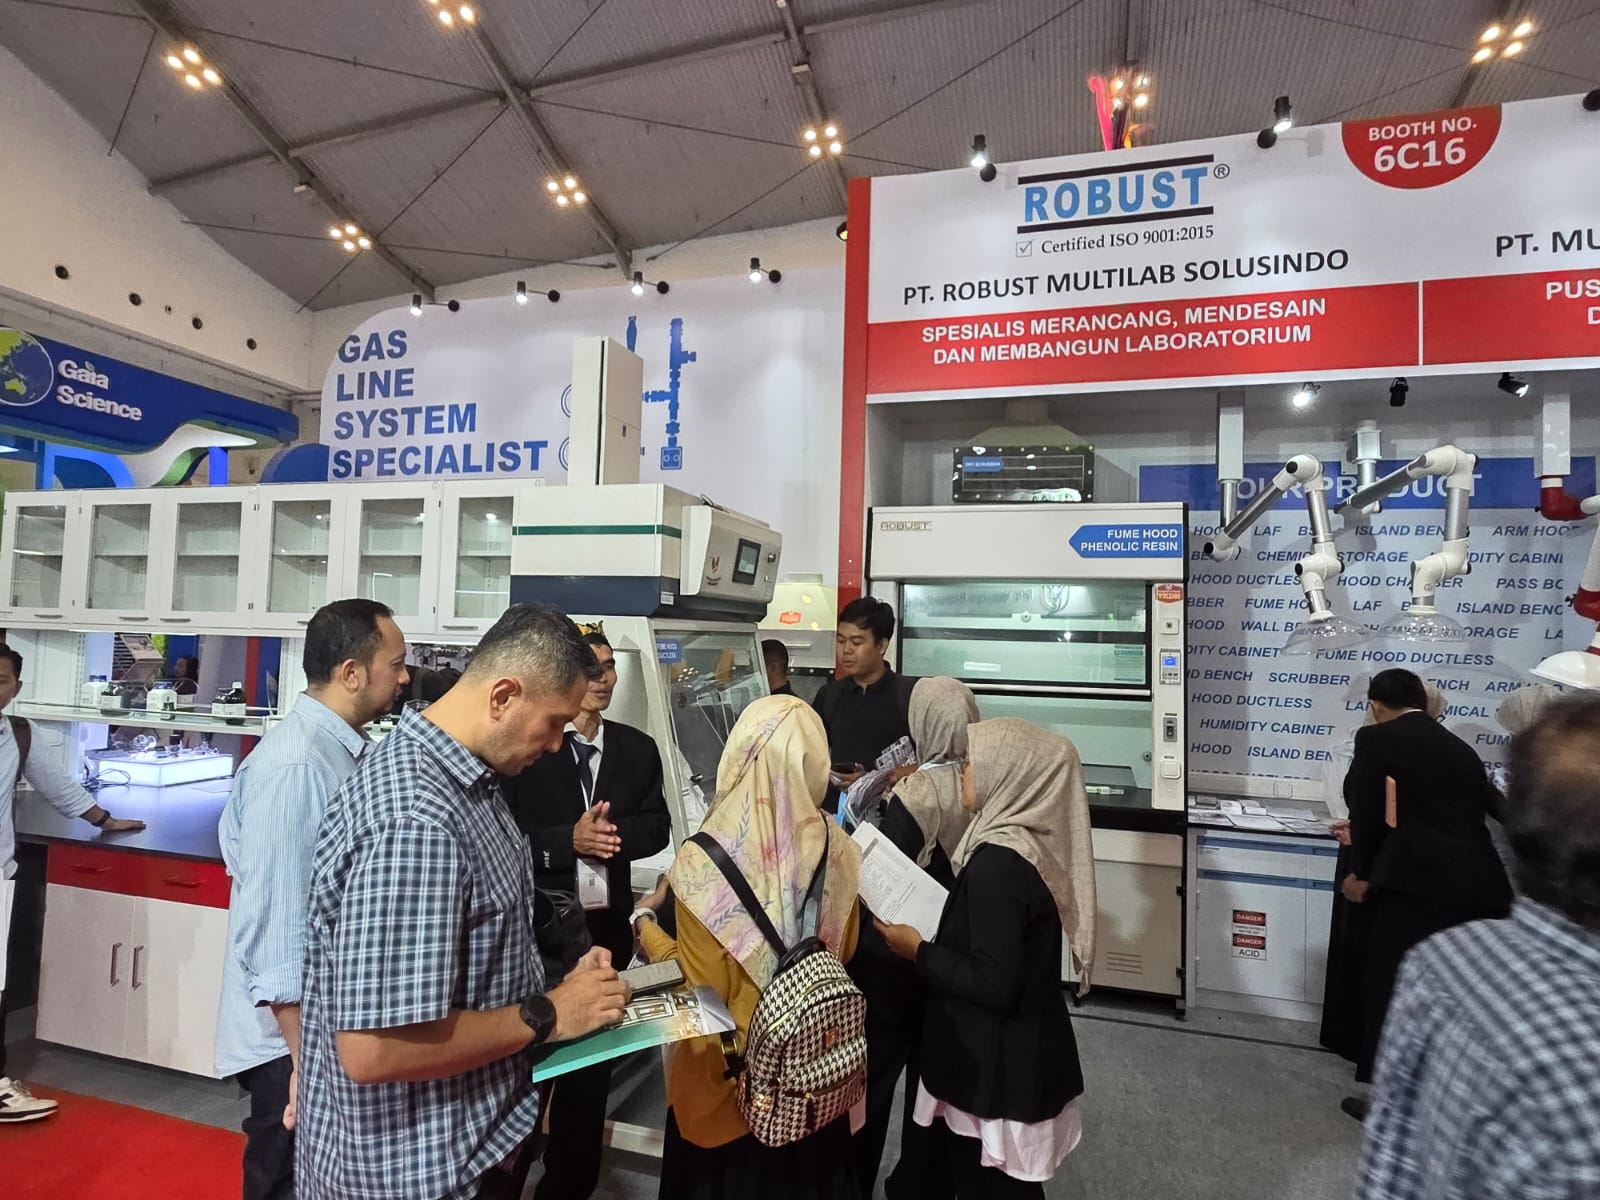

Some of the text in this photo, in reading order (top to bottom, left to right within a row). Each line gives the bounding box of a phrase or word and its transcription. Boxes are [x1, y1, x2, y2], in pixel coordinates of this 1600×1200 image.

[1368, 116, 1478, 142] BOOTH NO.
[1373, 137, 1467, 172] 6C16
[1024, 166, 1208, 223] ROBUST
[1041, 224, 1214, 254] Certified ISO 9001:2015
[1496, 233, 1539, 258] PT.
[903, 248, 1349, 306] PT. ROBUST MULTILAB SOLUSINDO
[921, 297, 1327, 343] SPESIALIS MERANCANG, MENDESAIN
[338, 329, 408, 363] GAS
[932, 324, 1312, 366] DAN MEMBANGUN LABORATORIUM
[58, 360, 109, 389] Gaia
[336, 367, 415, 402] LINE
[57, 385, 142, 420] Science
[334, 403, 477, 440] SYSTEM
[332, 440, 548, 478] SPECIALIST
[1107, 528, 1178, 539] FUME HOOD
[1254, 525, 1282, 537] LAF
[1355, 525, 1410, 537] ISLAND
[1492, 525, 1530, 537] ARM
[1080, 541, 1178, 551] PHENOLIC RESIN
[1336, 551, 1409, 562] STORAGE
[1191, 574, 1232, 585] HOOD
[1235, 575, 1302, 586] DUCTLES
[1336, 576, 1381, 587] HOOD
[1496, 578, 1538, 589] PASS
[1244, 598, 1285, 609] FUME
[1352, 600, 1383, 611] LAF
[1456, 602, 1516, 614] ISLAND
[1241, 621, 1281, 632] WALL
[1218, 646, 1281, 658] CABINET
[1315, 648, 1357, 661] FUME
[1361, 651, 1406, 663] HOOD
[1410, 652, 1495, 666] DUCTLESS
[1203, 669, 1253, 681] BENCH
[1268, 672, 1350, 686] SCRUBBER
[1191, 693, 1232, 705] HOOD
[1236, 695, 1313, 709] DUCTLESS
[1200, 718, 1511, 746] HUMIDITY CABINET FUM
[1191, 742, 1334, 763] HOOD ISLAND BEN
[1239, 948, 1260, 958] ACID
